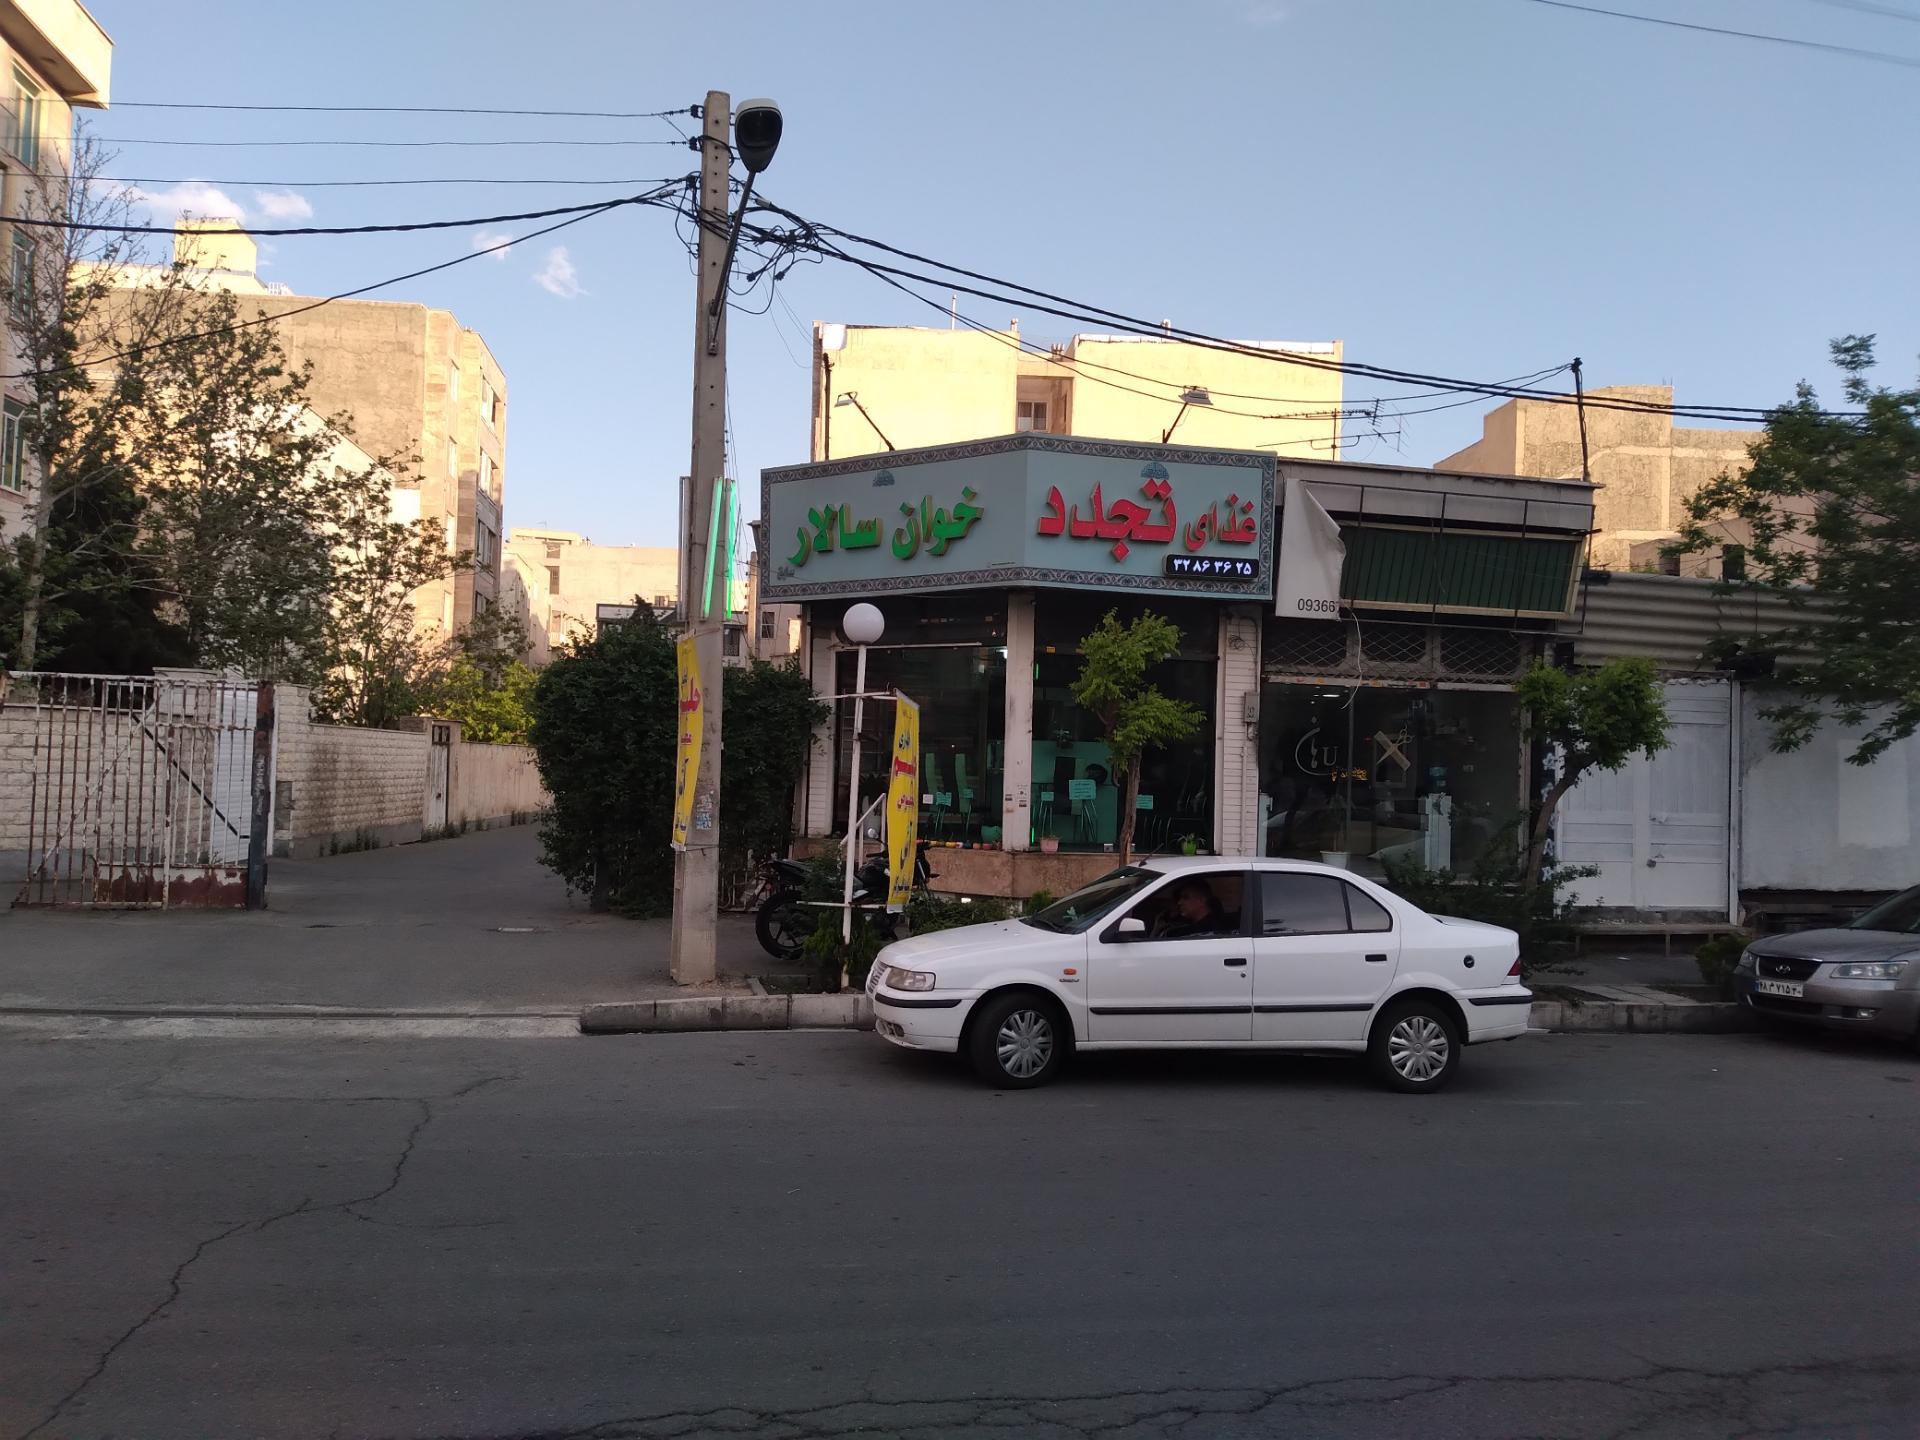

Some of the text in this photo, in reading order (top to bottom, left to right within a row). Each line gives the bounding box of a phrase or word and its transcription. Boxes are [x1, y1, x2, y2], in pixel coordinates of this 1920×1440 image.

[787, 486, 984, 567] خوان سالار
[1184, 494, 1258, 552] غذای
[1297, 598, 1336, 613] 09366
